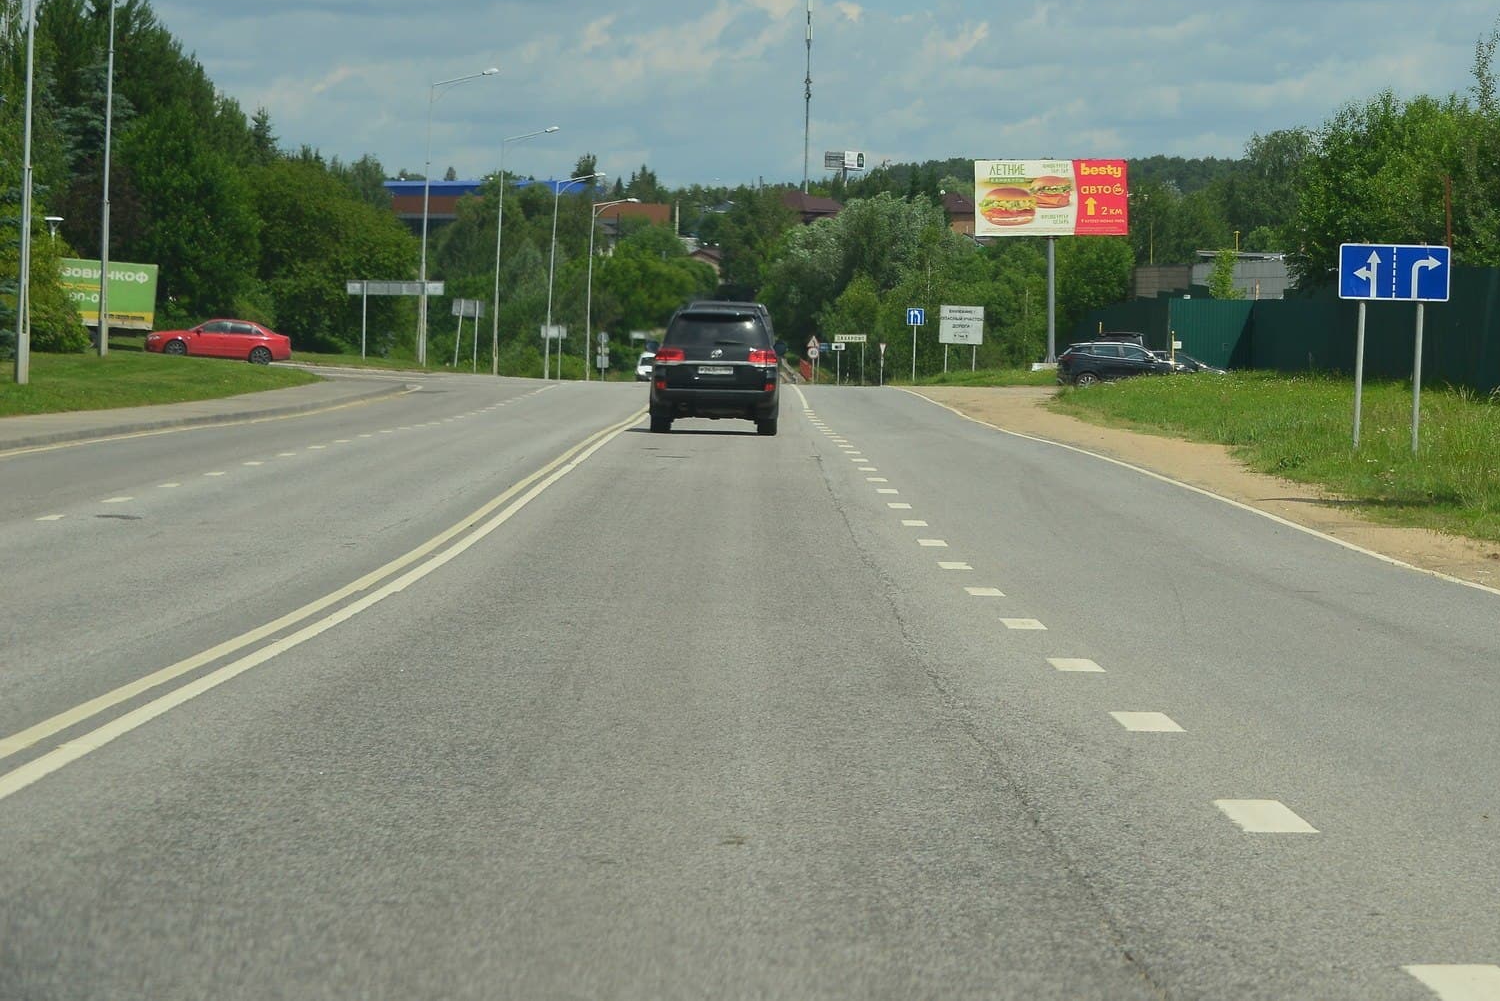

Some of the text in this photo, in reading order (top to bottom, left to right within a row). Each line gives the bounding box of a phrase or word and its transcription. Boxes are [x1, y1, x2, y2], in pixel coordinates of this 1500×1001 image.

[1080, 162, 1122, 178] besty
[1080, 185, 1112, 195] авто
[1101, 206, 1108, 215] 2
